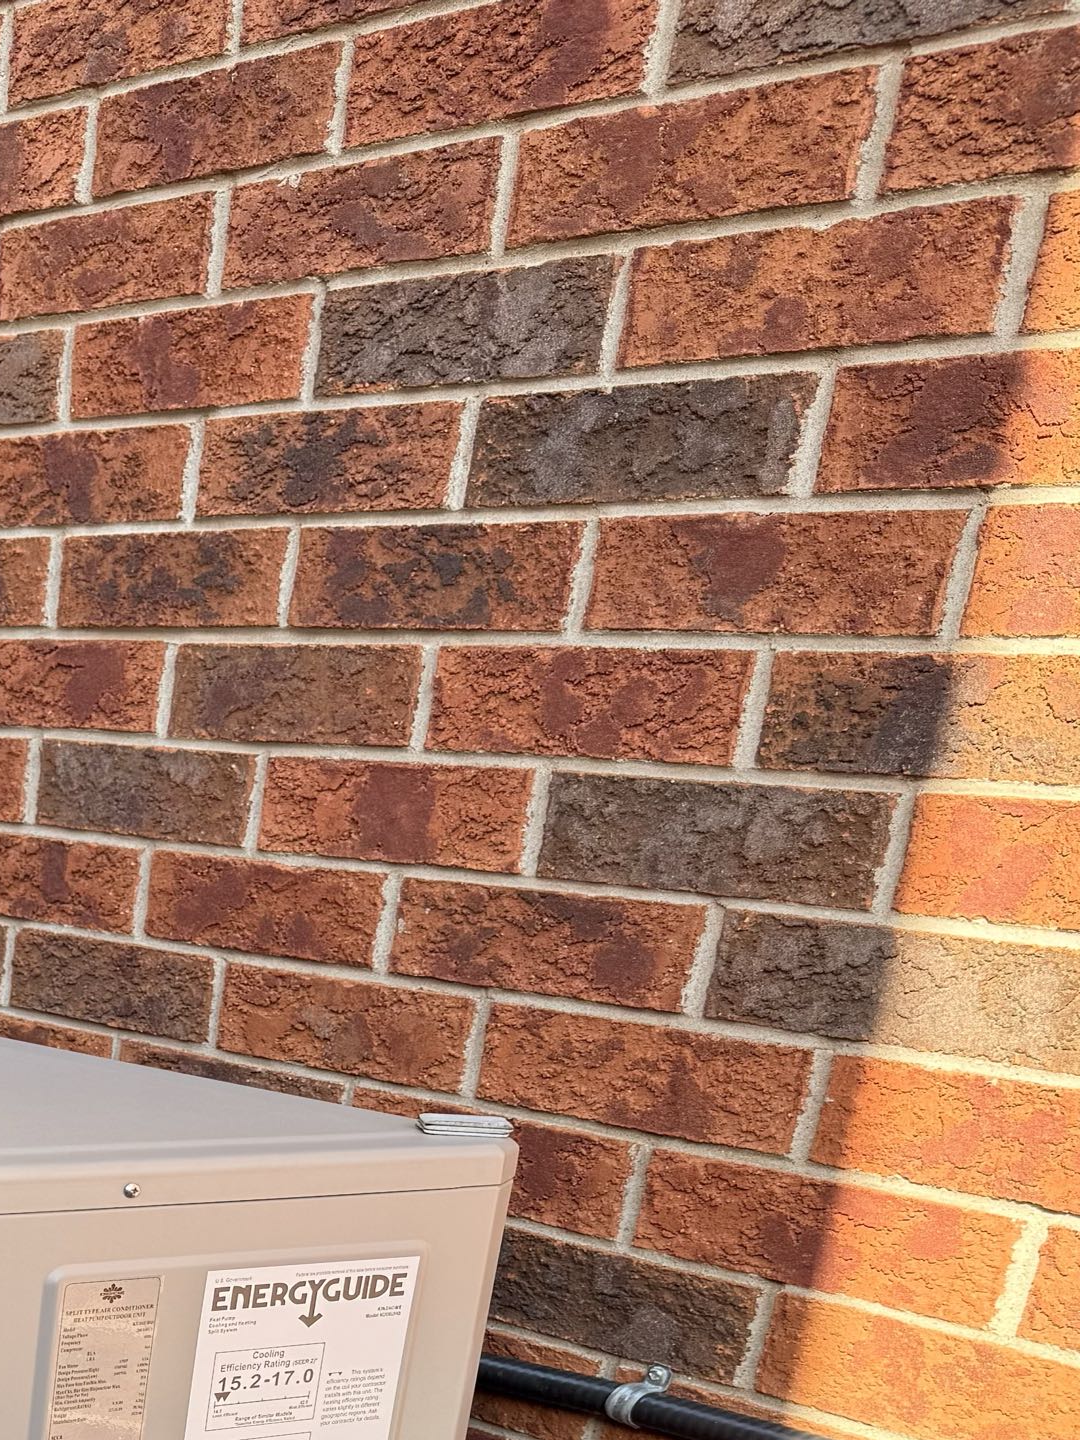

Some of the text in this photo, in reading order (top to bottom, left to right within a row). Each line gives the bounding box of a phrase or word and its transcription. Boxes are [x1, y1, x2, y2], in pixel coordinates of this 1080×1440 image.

[211, 1273, 408, 1311] ENERGYGUIDE
[112, 1304, 154, 1312] CONDITIONER
[253, 1350, 285, 1359] Cooling
[221, 1363, 261, 1372] Efficiency
[264, 1360, 290, 1368] Rating
[218, 1368, 314, 1391] 15.2-17.0
